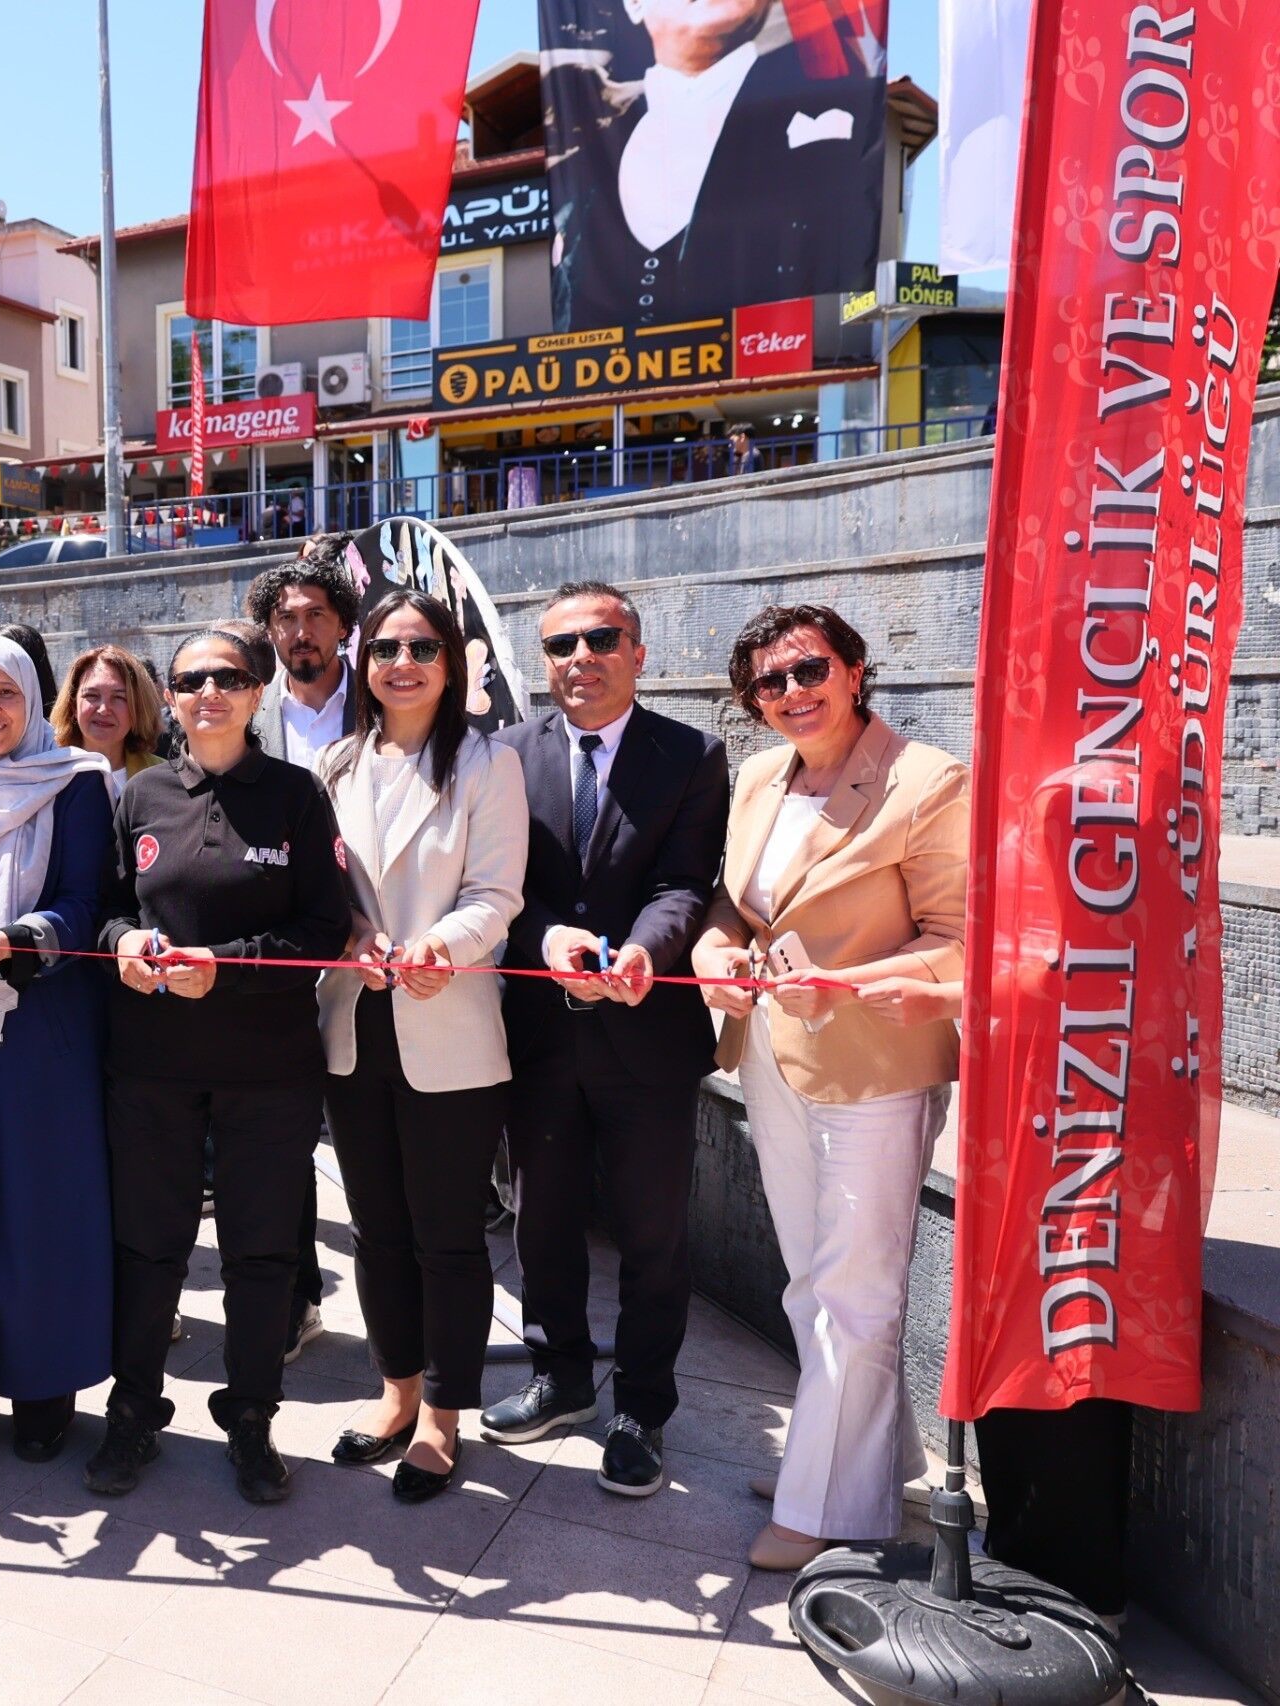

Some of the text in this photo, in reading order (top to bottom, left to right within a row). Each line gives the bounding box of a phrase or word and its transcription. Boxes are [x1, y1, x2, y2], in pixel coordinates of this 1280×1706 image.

[899, 284, 955, 306] DÖNER
[536, 331, 615, 350] ÖMER USTA
[740, 331, 807, 357] Teker
[484, 343, 724, 399] PAÜ DÖNER
[1032, 5, 1197, 1359] DENİZLİ GENÇLİK VE SPOR
[244, 846, 289, 866] AFAD
